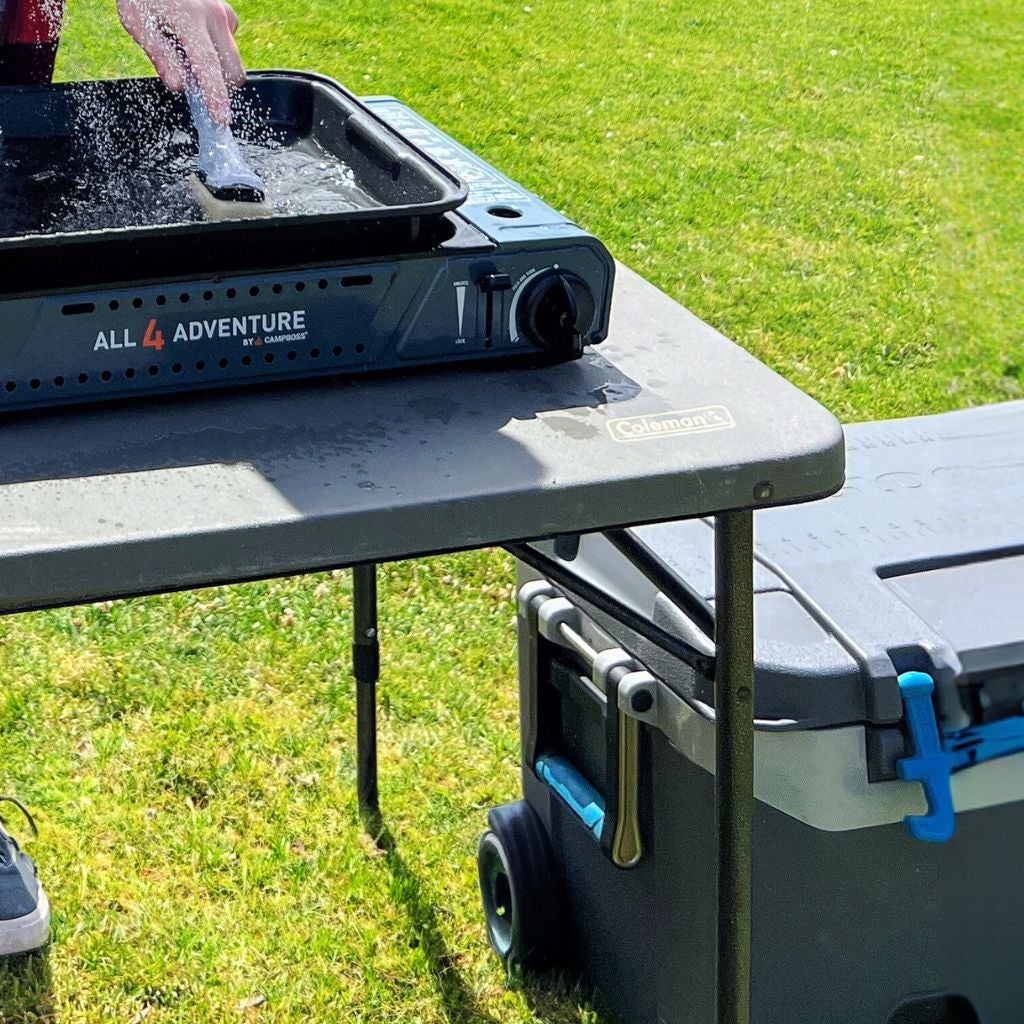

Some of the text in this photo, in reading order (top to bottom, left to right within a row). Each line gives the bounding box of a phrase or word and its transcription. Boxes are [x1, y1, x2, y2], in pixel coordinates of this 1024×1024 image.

[93, 309, 306, 351] ALL 4 ADVENTURE
[242, 337, 254, 347] BY
[615, 414, 708, 436] Coleman
